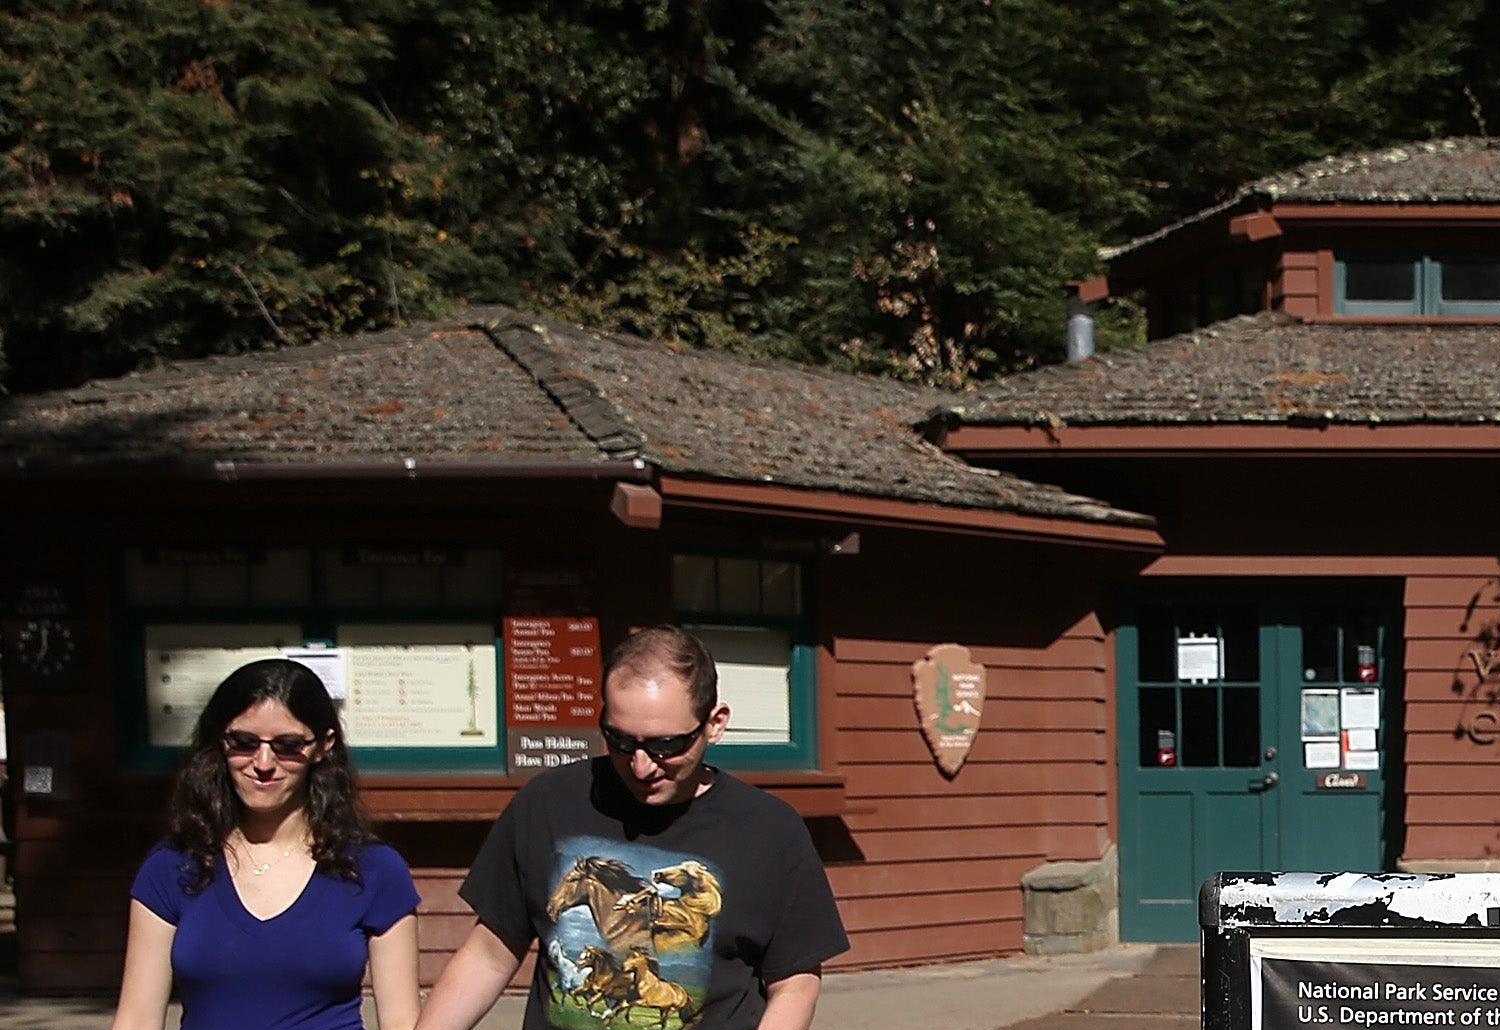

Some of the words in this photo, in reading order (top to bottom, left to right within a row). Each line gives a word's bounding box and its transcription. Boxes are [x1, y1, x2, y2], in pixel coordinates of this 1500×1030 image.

[1298, 982, 1378, 1000] National
[1385, 983, 1426, 1000] Park
[1432, 984, 1498, 1001] Service
[1298, 1006, 1334, 1024] U.S.
[1340, 1007, 1456, 1027] Department
[1460, 1008, 1482, 1026] of
